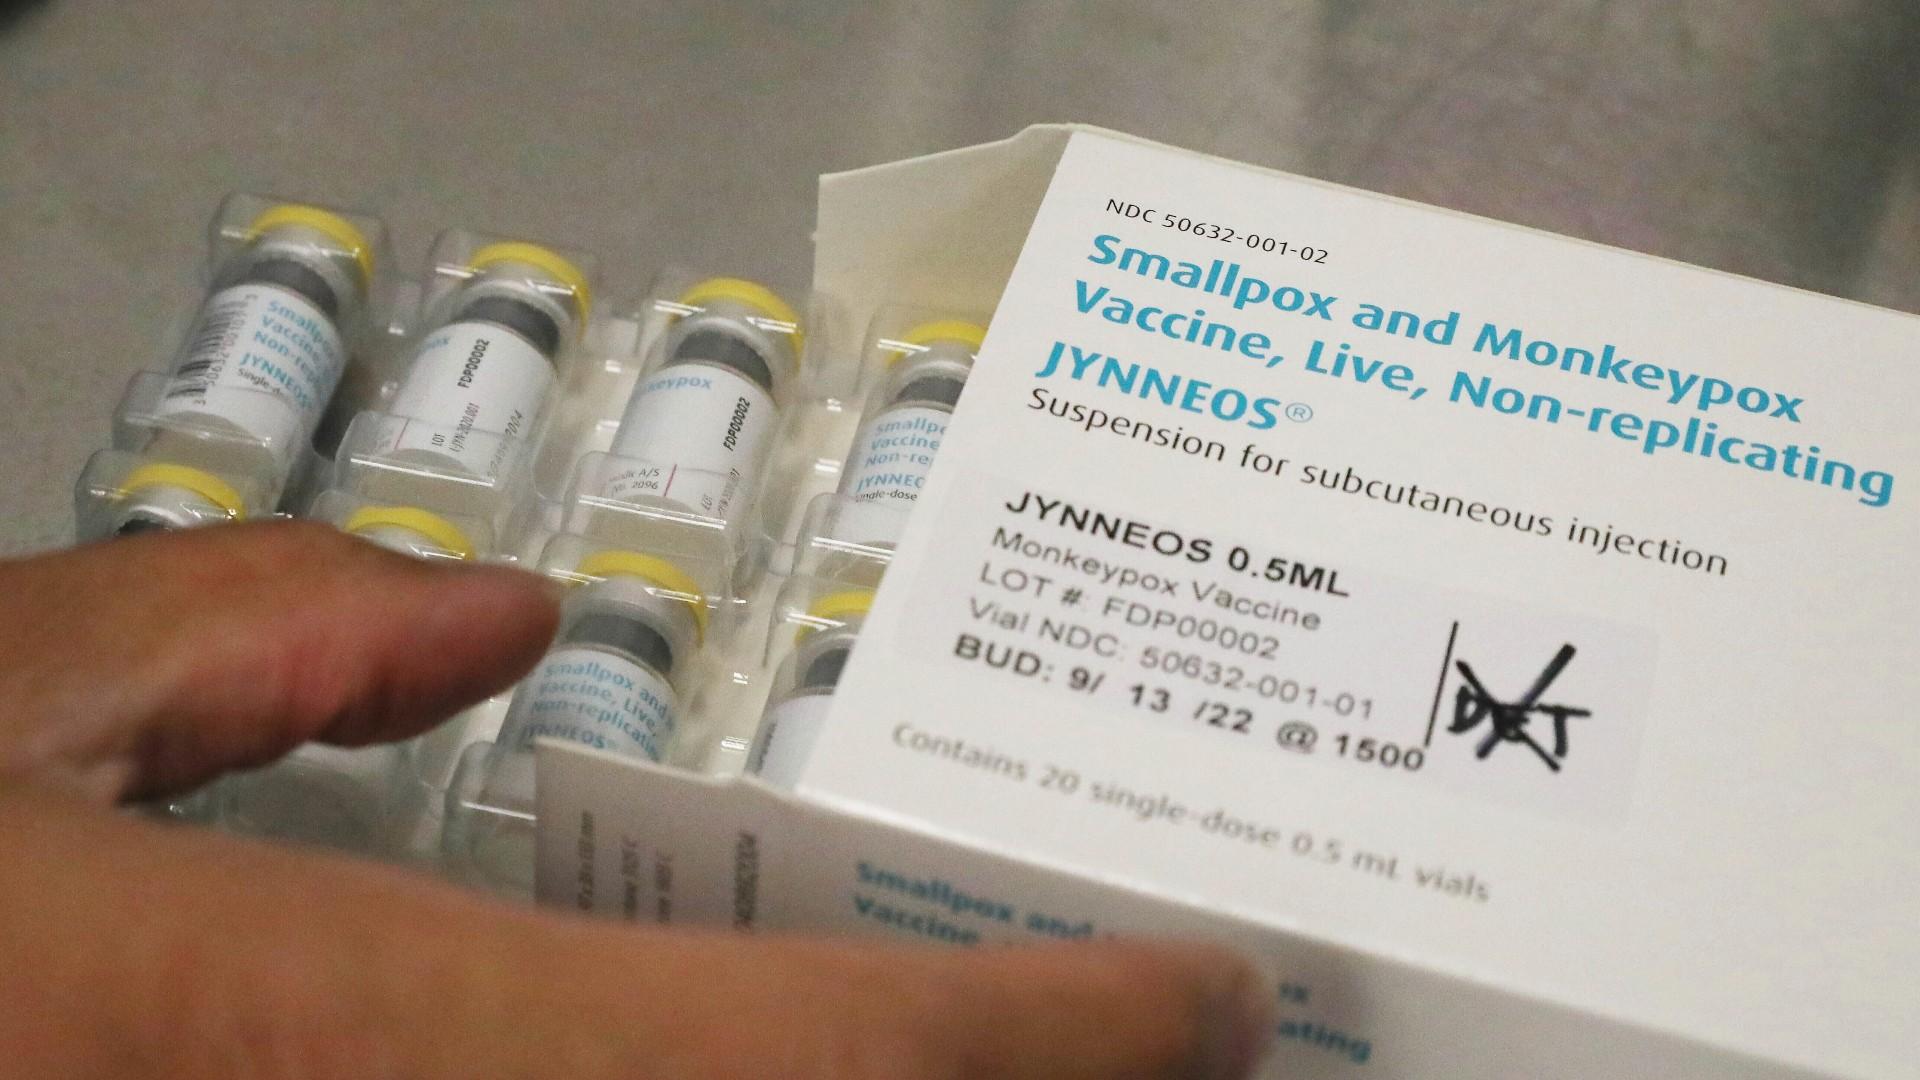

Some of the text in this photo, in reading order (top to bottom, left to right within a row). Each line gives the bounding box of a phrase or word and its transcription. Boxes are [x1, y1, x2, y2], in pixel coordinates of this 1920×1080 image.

[1106, 199, 1329, 265] NDC 50632-001-02
[458, 339, 490, 389] FDP00002
[1087, 234, 1805, 423] Smallpox and Monkeypox
[723, 396, 751, 451] FDP00002
[1075, 279, 1895, 508] Vaccine, Live, Non-replicating
[639, 467, 660, 478] A/S
[1028, 387, 1729, 577] Suspension for subcutaneous injection
[991, 527, 1322, 631] Monkeypox Vaccine
[1005, 492, 1350, 598] JYNNEOS 0.5ML
[968, 596, 1374, 719] Vial NDC: 50632-001-01
[979, 562, 1054, 597] LOT
[1102, 596, 1280, 661] FDP00002
[953, 633, 1056, 683] BUD:
[1128, 682, 1171, 713] 13
[1193, 700, 1254, 735] /22
[1276, 721, 1318, 753] @
[1334, 733, 1425, 771] 1500
[891, 721, 1027, 782] Contains
[1038, 766, 1082, 795] 20
[1089, 781, 1281, 848] single-dose
[1291, 832, 1343, 866] 0.5
[1414, 864, 1492, 903] vials
[857, 862, 1014, 923] Smallpox
